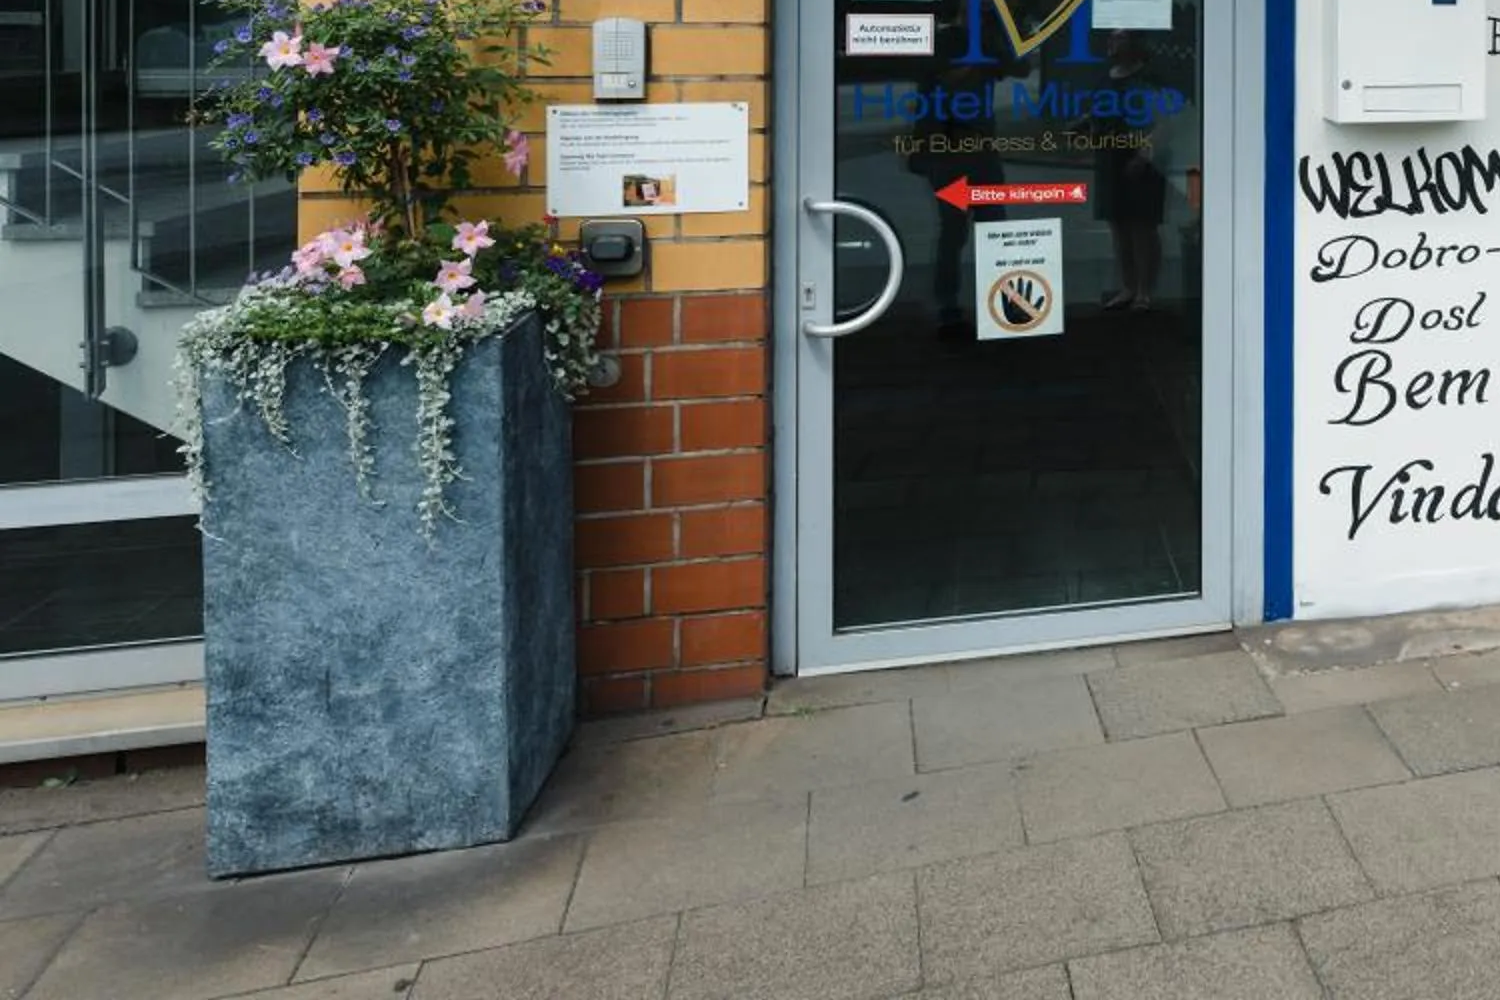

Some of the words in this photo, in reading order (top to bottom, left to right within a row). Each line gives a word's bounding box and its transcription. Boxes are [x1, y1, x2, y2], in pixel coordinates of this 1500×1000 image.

[853, 79, 995, 123] Hotel
[1012, 80, 1186, 126] Mirage
[893, 135, 925, 155] für
[929, 134, 1035, 153] Business
[1041, 131, 1057, 151] &
[1064, 130, 1154, 150] Touristik
[971, 187, 1006, 201] Bitte
[1010, 186, 1065, 202] klingeln
[1350, 291, 1487, 344] Dosl
[1328, 349, 1491, 426] Bem
